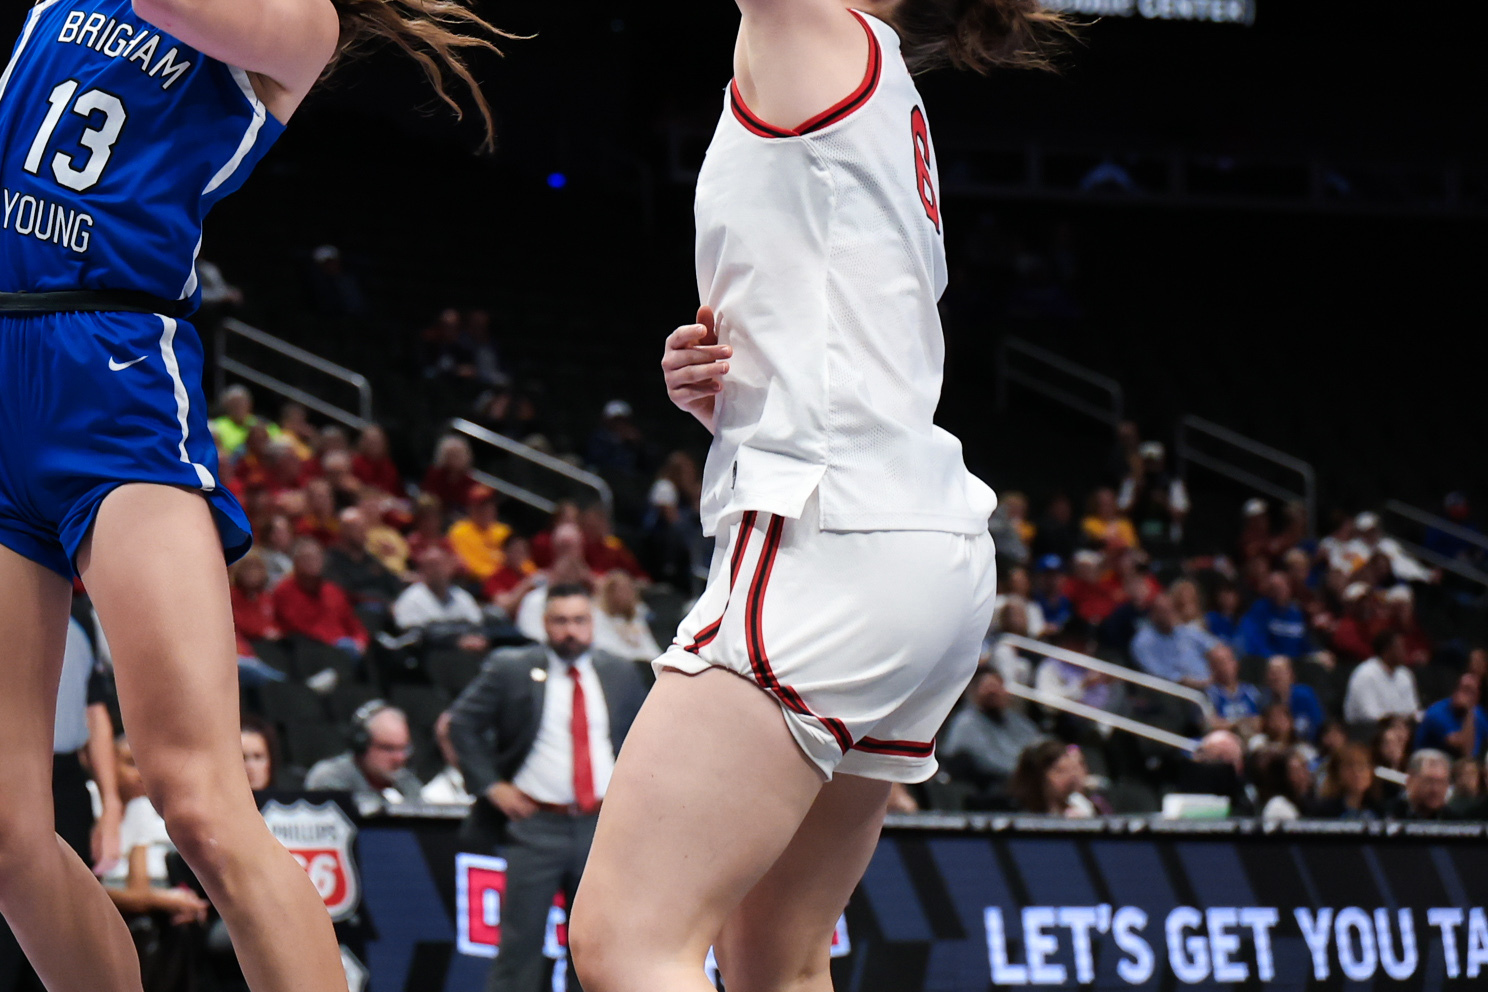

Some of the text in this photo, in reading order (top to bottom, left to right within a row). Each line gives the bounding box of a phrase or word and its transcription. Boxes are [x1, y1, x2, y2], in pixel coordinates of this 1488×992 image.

[58, 10, 191, 90] BRIGHAM
[22, 77, 127, 192] 13
[2, 188, 94, 254] YOUNG
[983, 904, 1157, 985] LET'S
[1165, 906, 1279, 984] GET
[1294, 906, 1419, 982] YOU
